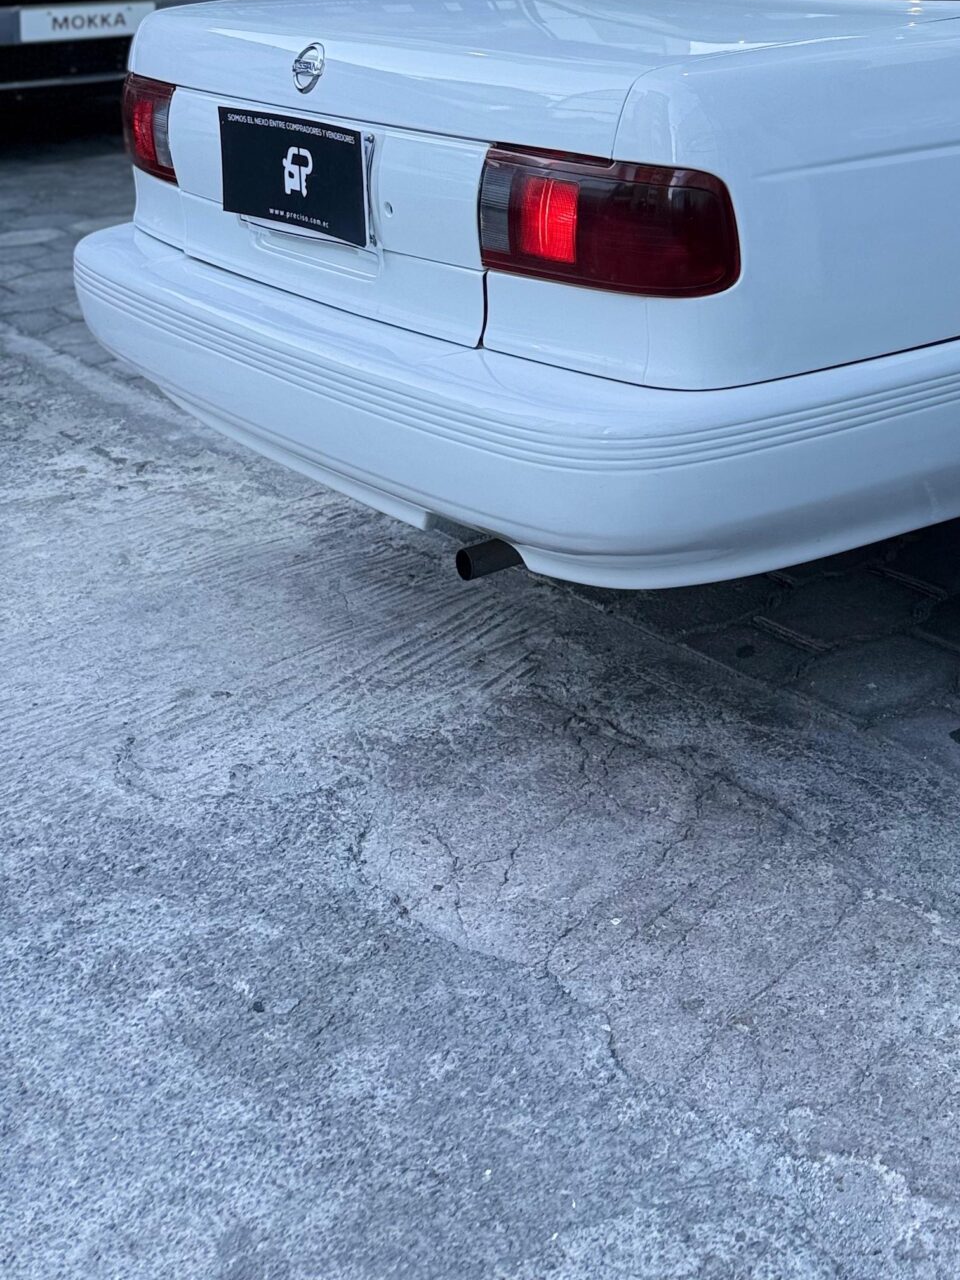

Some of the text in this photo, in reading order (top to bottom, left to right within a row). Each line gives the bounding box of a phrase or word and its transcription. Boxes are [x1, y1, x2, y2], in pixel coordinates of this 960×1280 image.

[51, 13, 126, 31] MOKKA
[227, 113, 247, 124] SOMOS
[247, 116, 254, 125] EL
[254, 117, 269, 127] NEXO
[269, 119, 286, 129] ENTRE
[286, 122, 322, 137] COMPRADORES
[325, 130, 355, 145] VENDEDORES
[268, 207, 329, 229] www.preciso.com.ec
